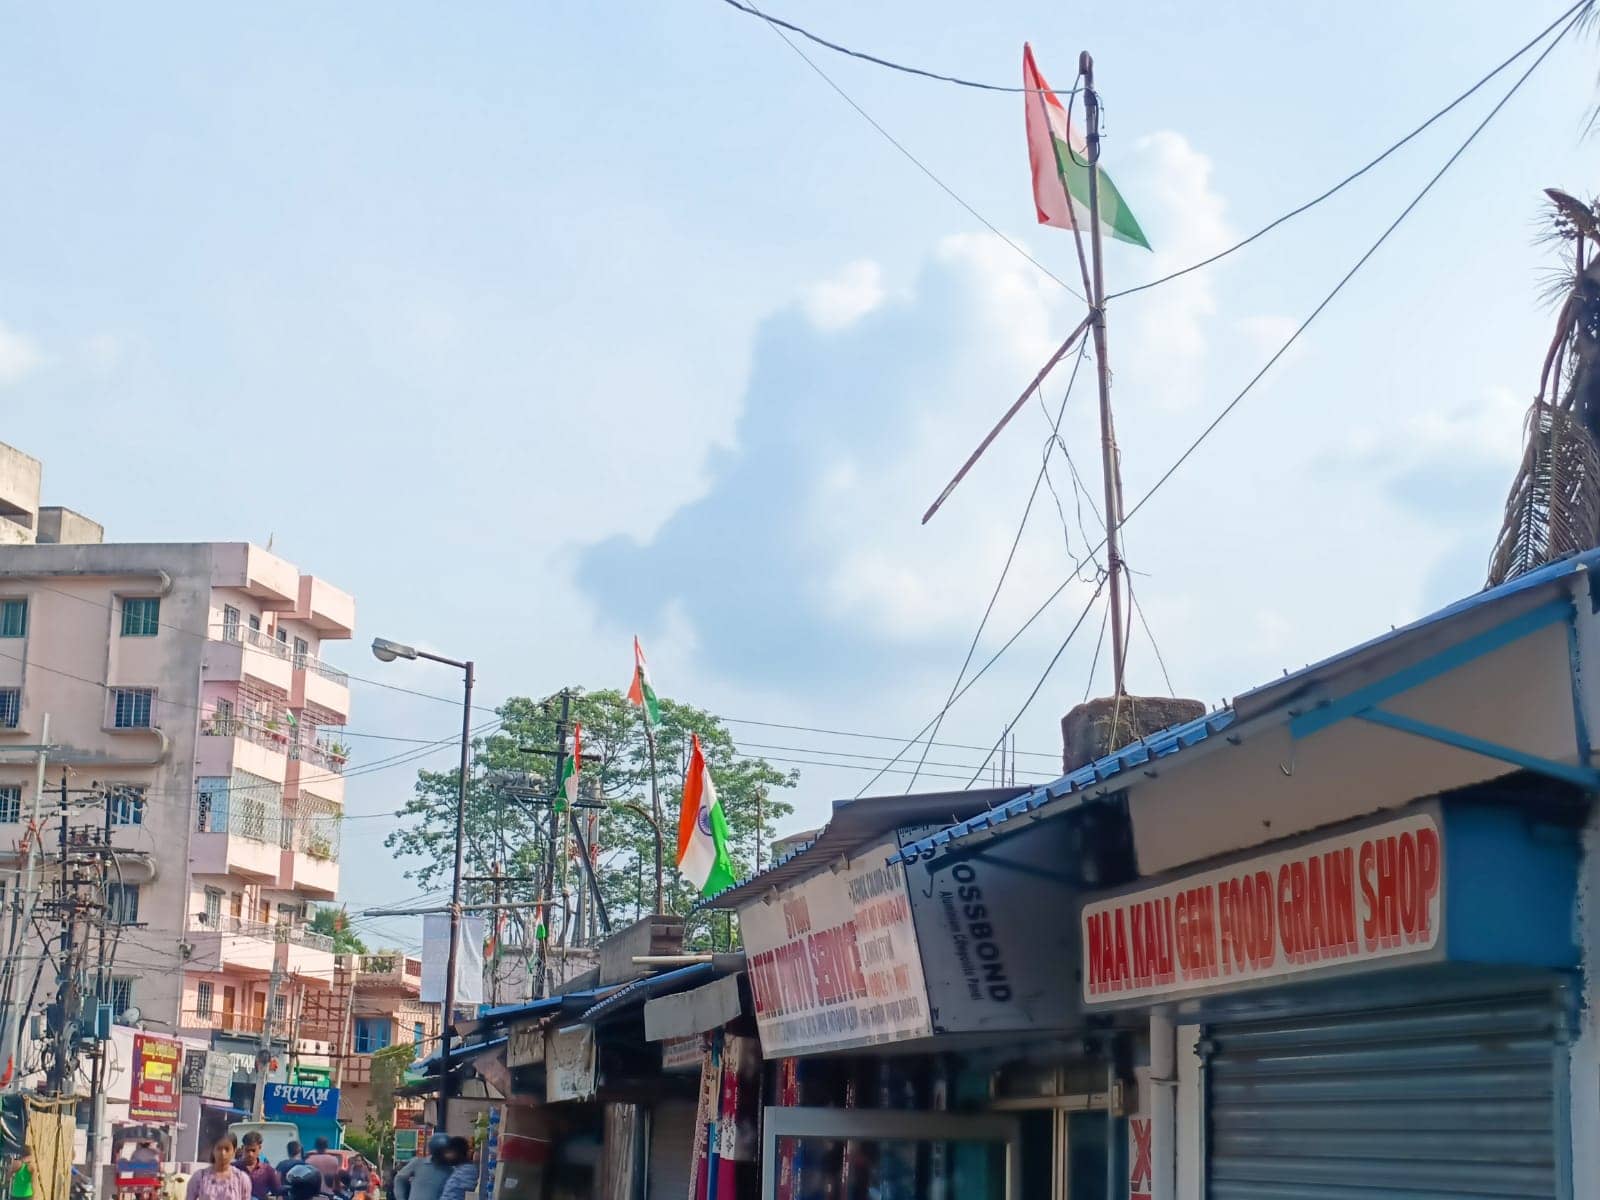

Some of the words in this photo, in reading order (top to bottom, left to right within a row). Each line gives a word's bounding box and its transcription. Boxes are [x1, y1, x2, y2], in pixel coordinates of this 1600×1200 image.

[1087, 909, 1132, 995] MAA
[1130, 897, 1176, 989] KALI
[1175, 884, 1218, 982] GEN
[1218, 869, 1277, 976] FOOD
[1277, 847, 1360, 965] GRAIN
[1359, 827, 1439, 952] SHOP
[273, 1085, 330, 1105] SHIVAM
